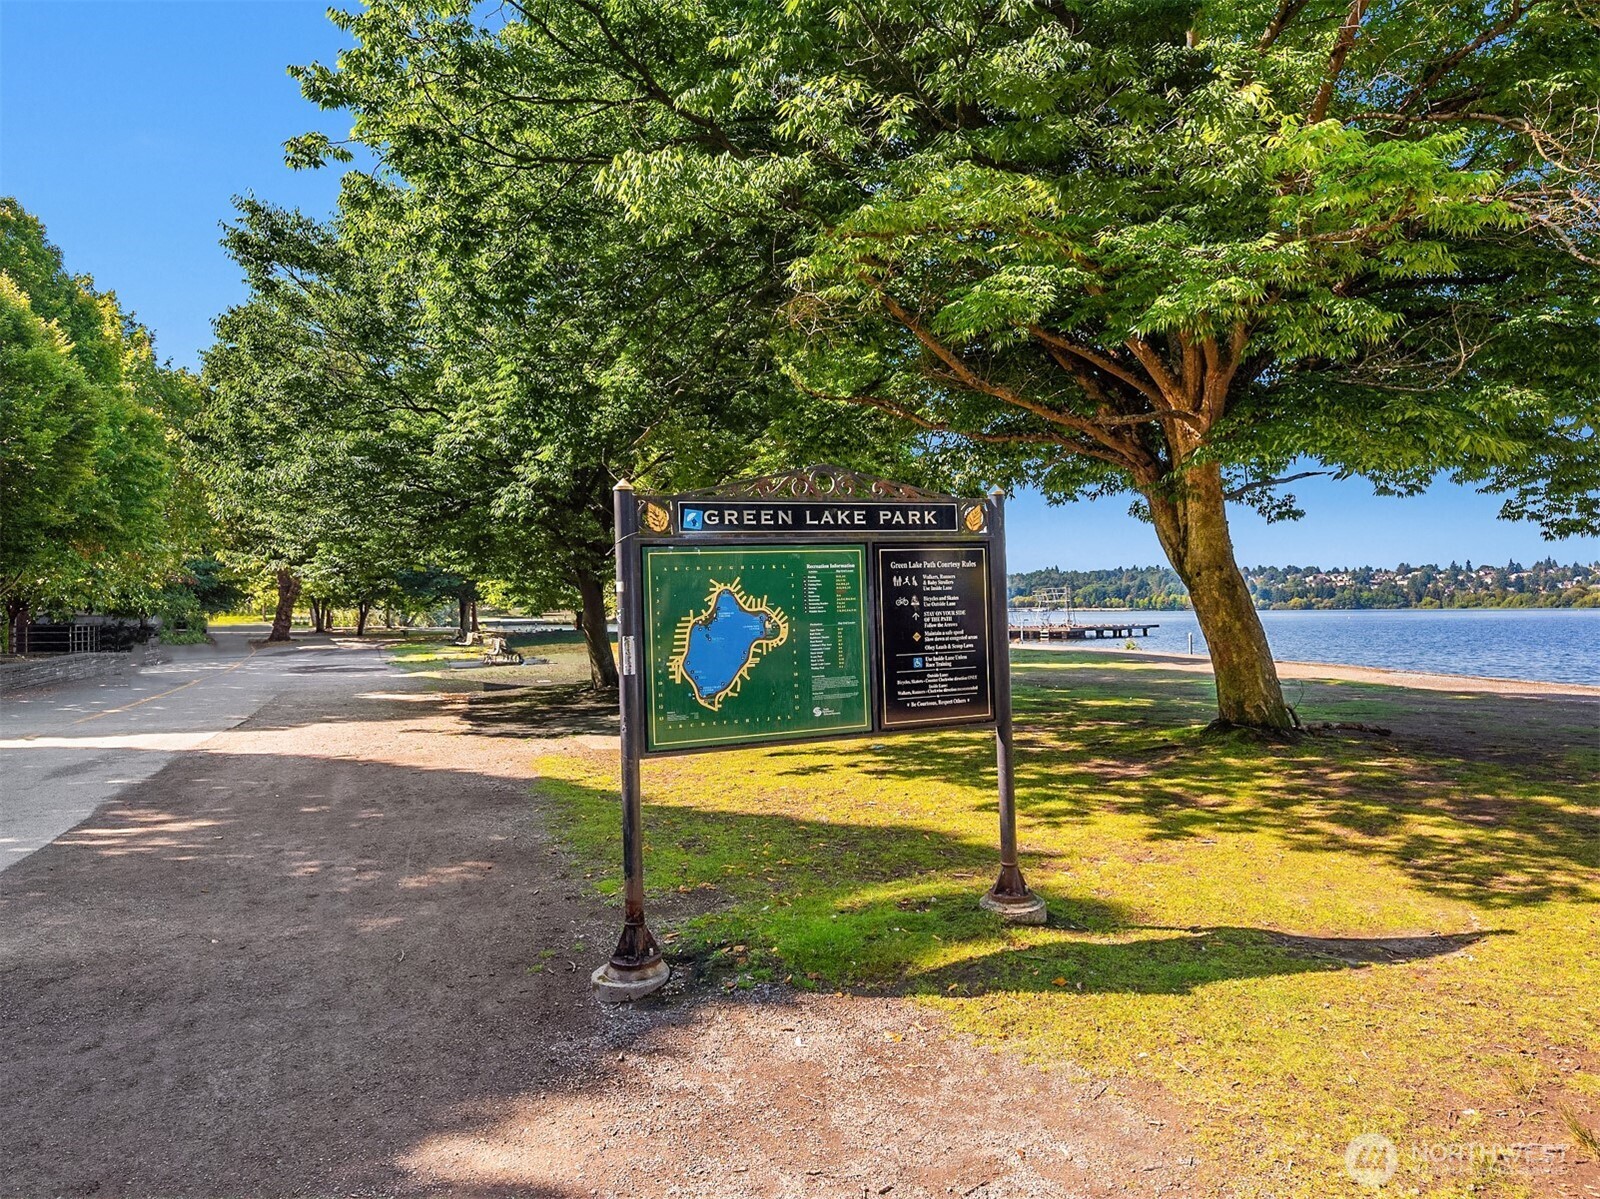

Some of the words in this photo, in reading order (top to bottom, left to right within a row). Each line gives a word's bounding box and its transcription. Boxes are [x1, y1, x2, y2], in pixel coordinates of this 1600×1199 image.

[703, 509, 793, 526] GREEN
[806, 510, 866, 525] LAKE
[879, 510, 938, 525] PARK
